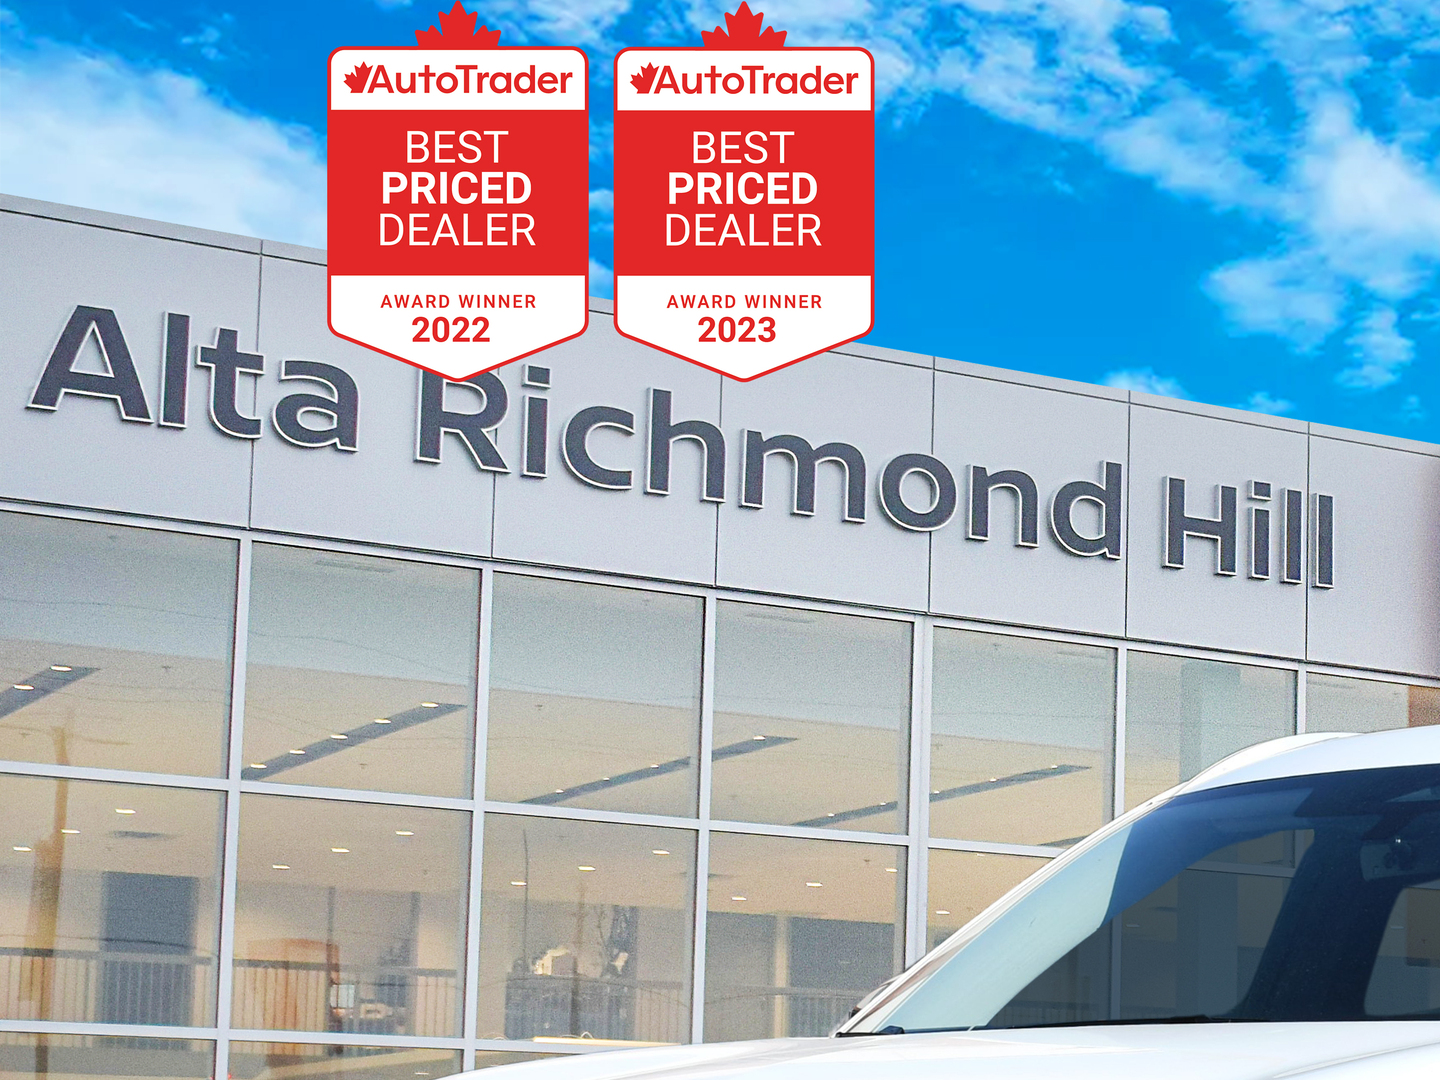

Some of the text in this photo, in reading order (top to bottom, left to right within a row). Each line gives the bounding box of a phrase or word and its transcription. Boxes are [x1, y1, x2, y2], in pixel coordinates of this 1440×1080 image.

[27, 304, 1335, 590] Alta Richmond Hill
